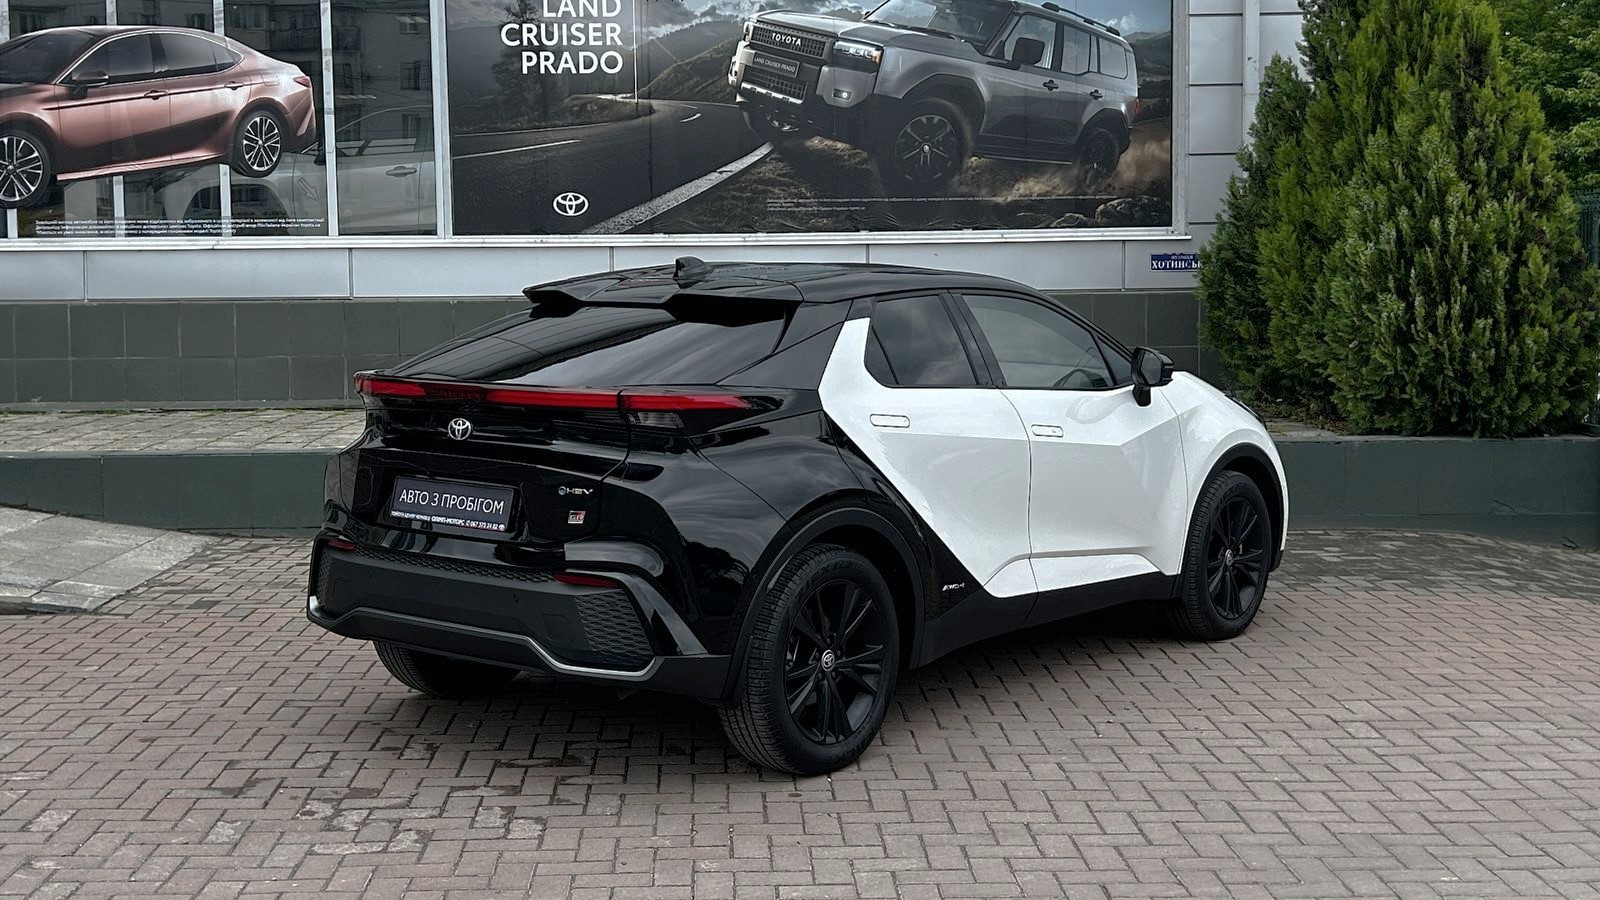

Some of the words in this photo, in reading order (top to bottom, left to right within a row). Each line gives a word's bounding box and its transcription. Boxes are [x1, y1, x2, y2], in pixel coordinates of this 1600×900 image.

[543, 0, 621, 18] LAND
[500, 23, 623, 47] CRUISER
[771, 32, 802, 46] TOYOTA
[522, 51, 623, 75] PRADO
[754, 56, 765, 64] LAND
[764, 58, 781, 69] CRUISER
[780, 63, 796, 73] PRADO
[567, 487, 594, 495] HEV
[399, 489, 429, 506] АВТО
[441, 494, 505, 515] ПРОБІГОМ
